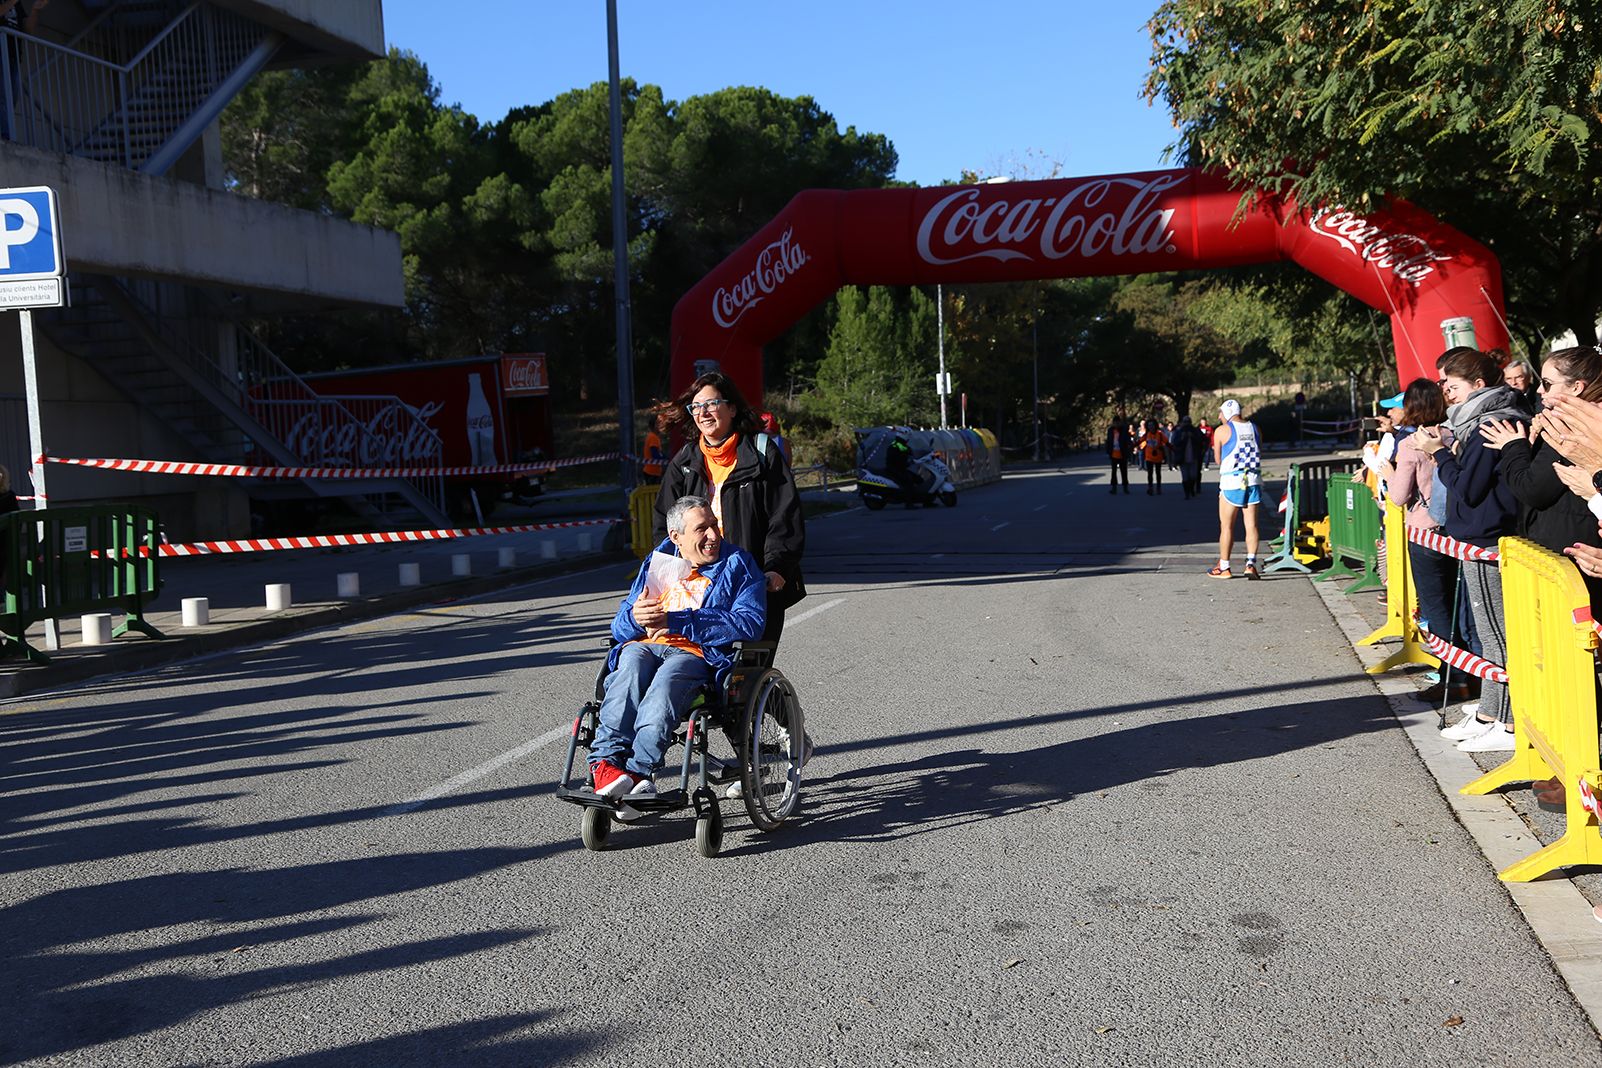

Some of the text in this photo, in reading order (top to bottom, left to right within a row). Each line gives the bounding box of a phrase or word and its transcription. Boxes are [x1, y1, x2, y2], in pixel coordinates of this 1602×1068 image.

[0, 198, 40, 270] P
[917, 174, 1190, 265] Coca-Cola
[37, 283, 56, 291] Hotel
[712, 225, 806, 328] Coca-Cola
